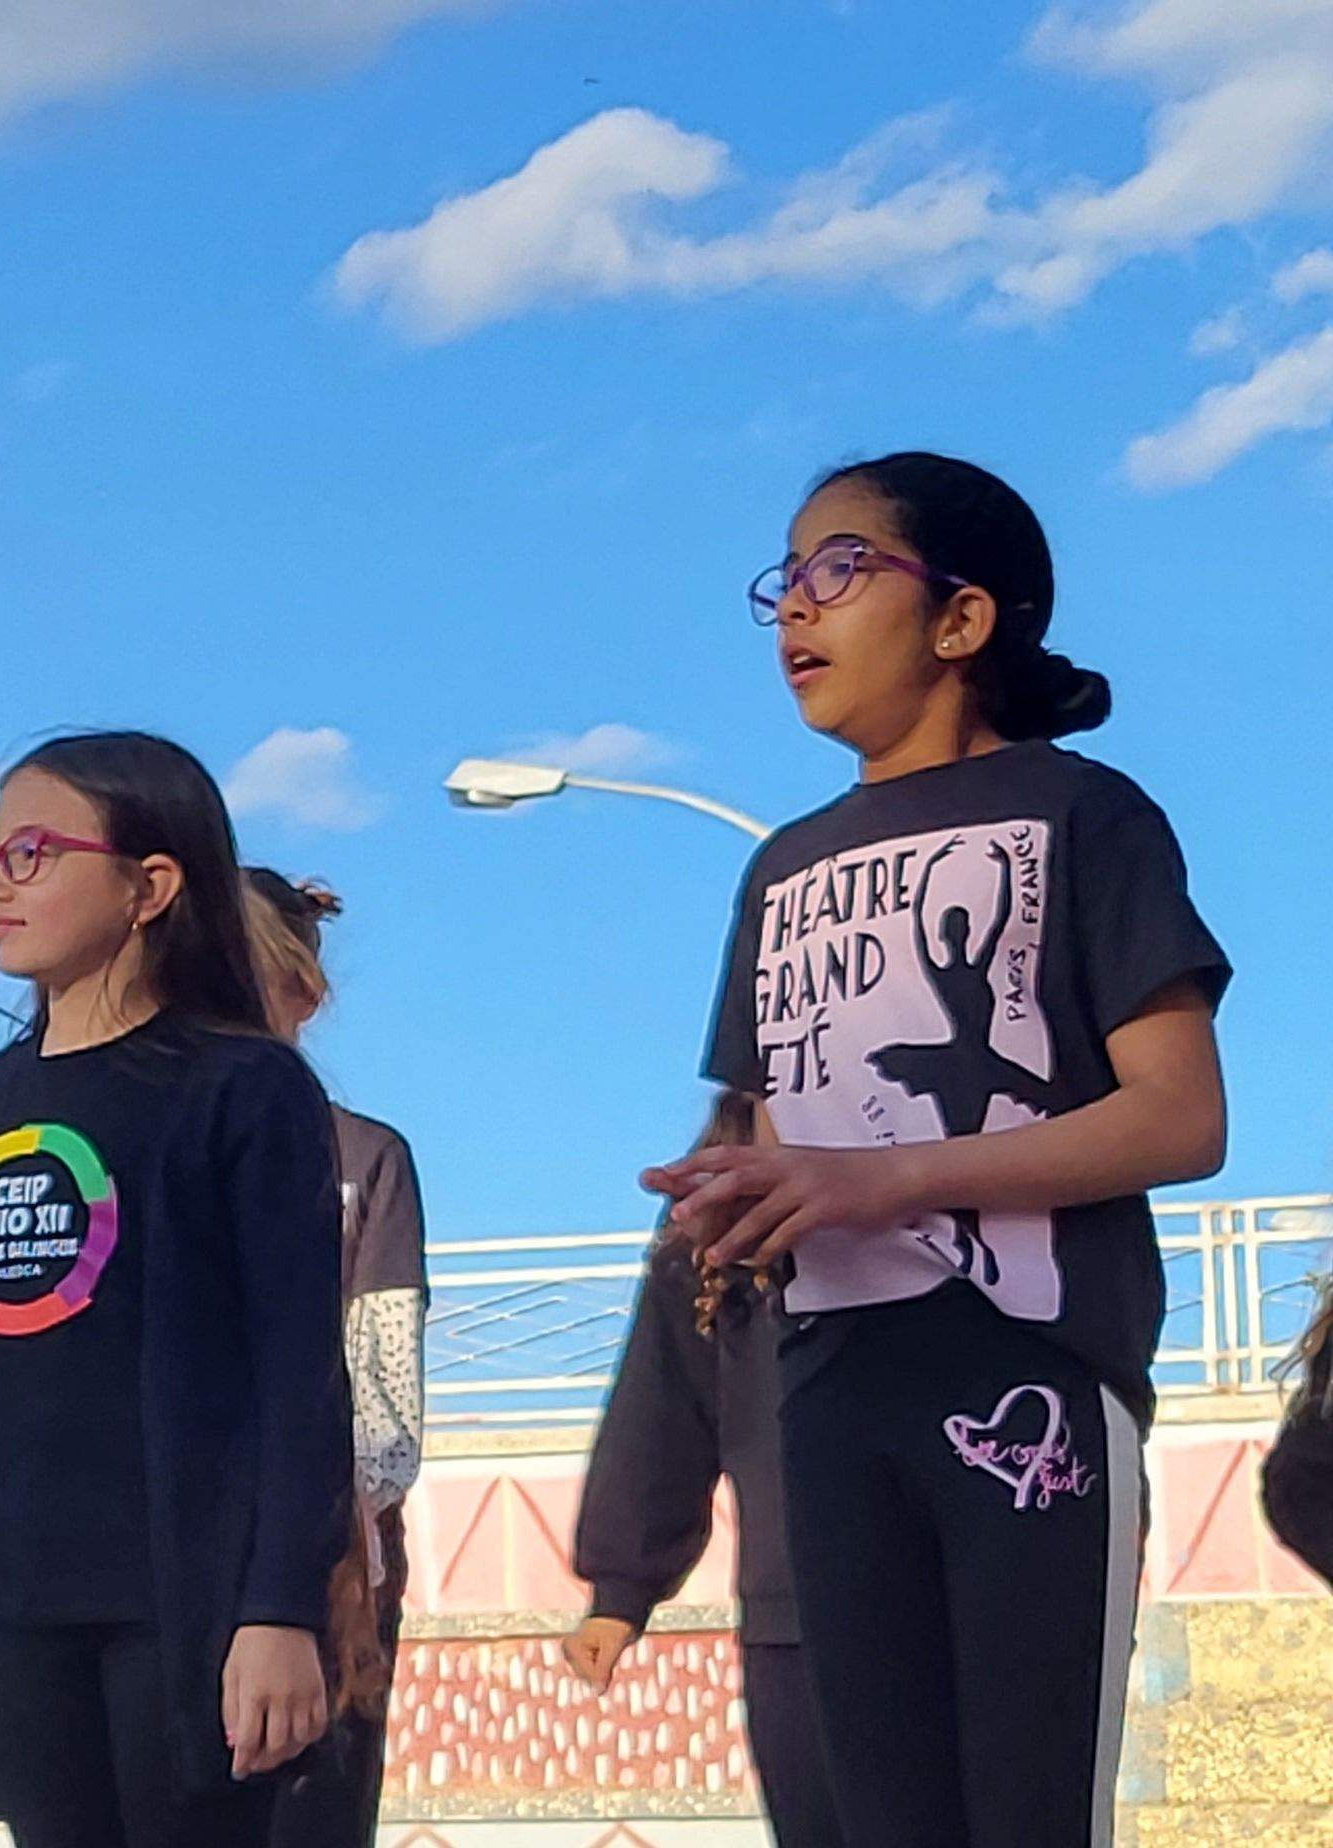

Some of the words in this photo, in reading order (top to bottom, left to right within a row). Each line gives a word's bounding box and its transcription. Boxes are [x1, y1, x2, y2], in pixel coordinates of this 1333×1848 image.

[1010, 825, 1040, 925] FRANCE
[756, 931, 886, 1024] GRAND
[35, 1203, 72, 1235] XII
